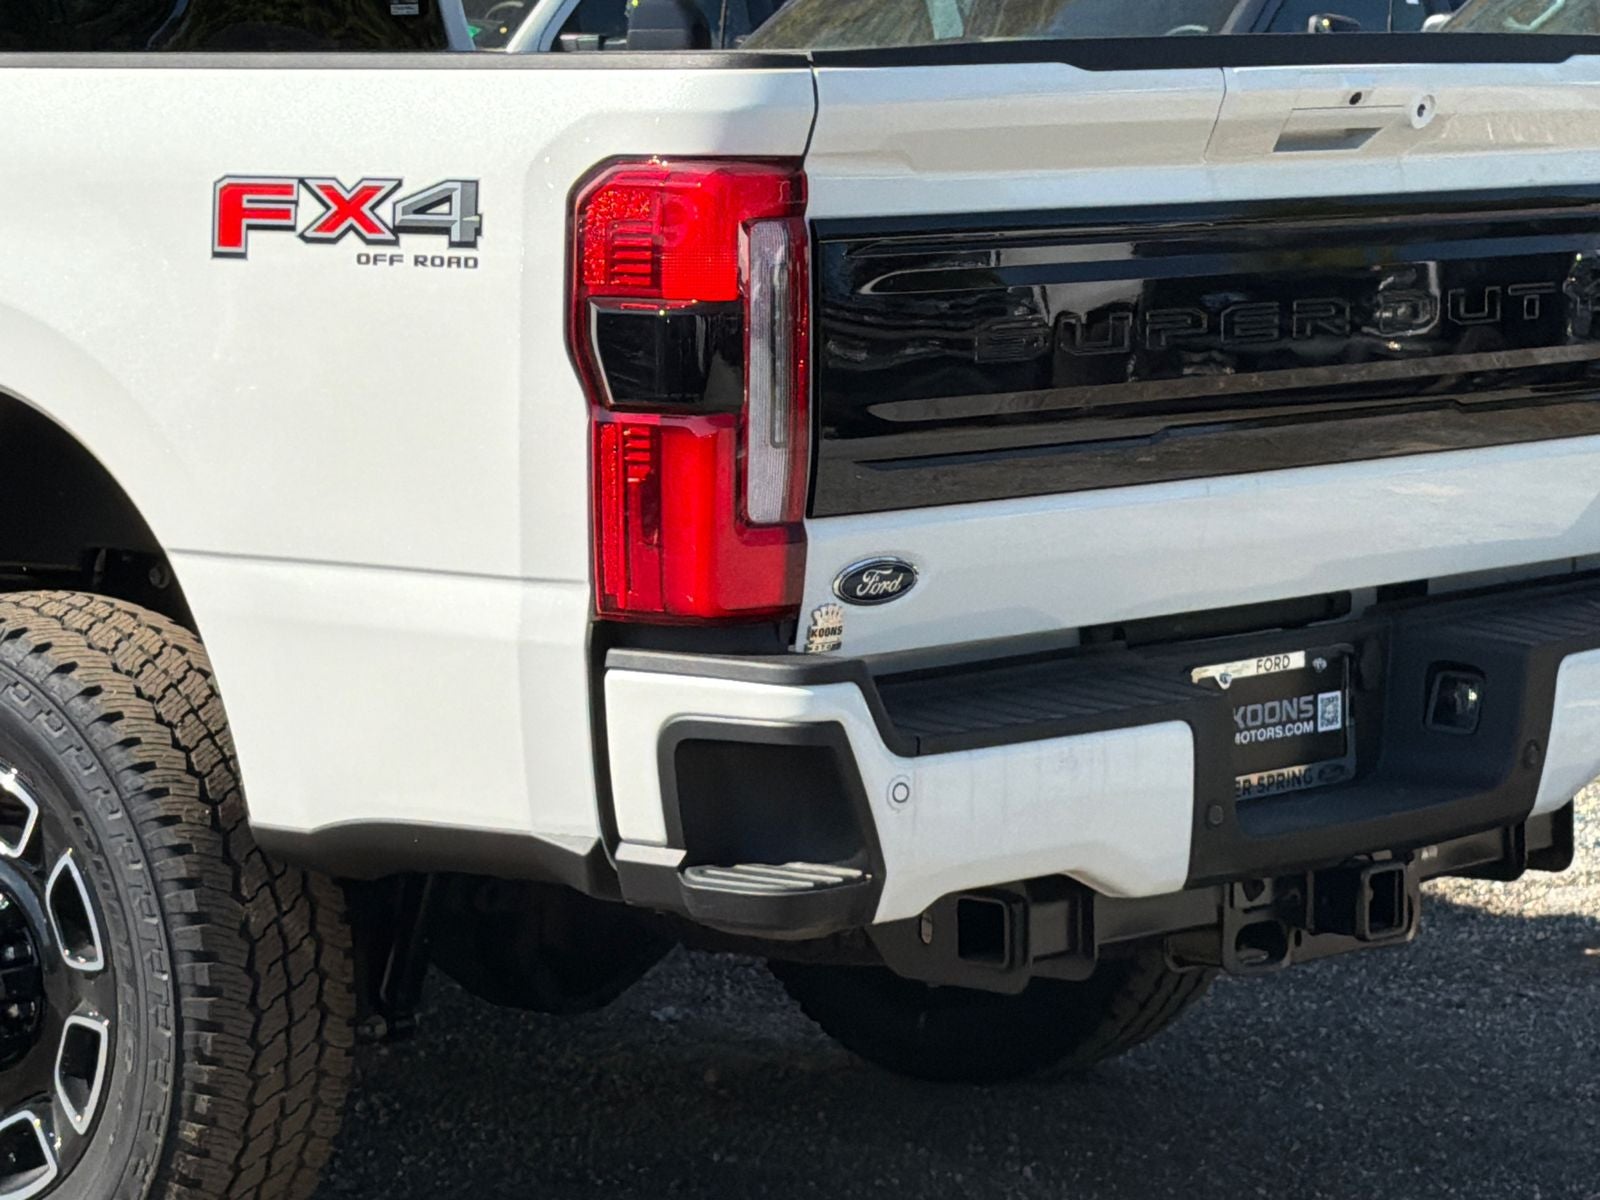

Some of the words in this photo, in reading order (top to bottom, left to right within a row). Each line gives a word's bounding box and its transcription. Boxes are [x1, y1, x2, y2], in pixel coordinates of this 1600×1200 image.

[211, 175, 482, 260] FX4
[356, 252, 404, 266] OFF
[413, 254, 479, 269] ROAD
[974, 296, 1352, 365] SUPER
[856, 568, 904, 596] Ford
[810, 625, 843, 639] KOONS
[1256, 654, 1291, 674] FORD
[1257, 768, 1313, 794] SPRING
